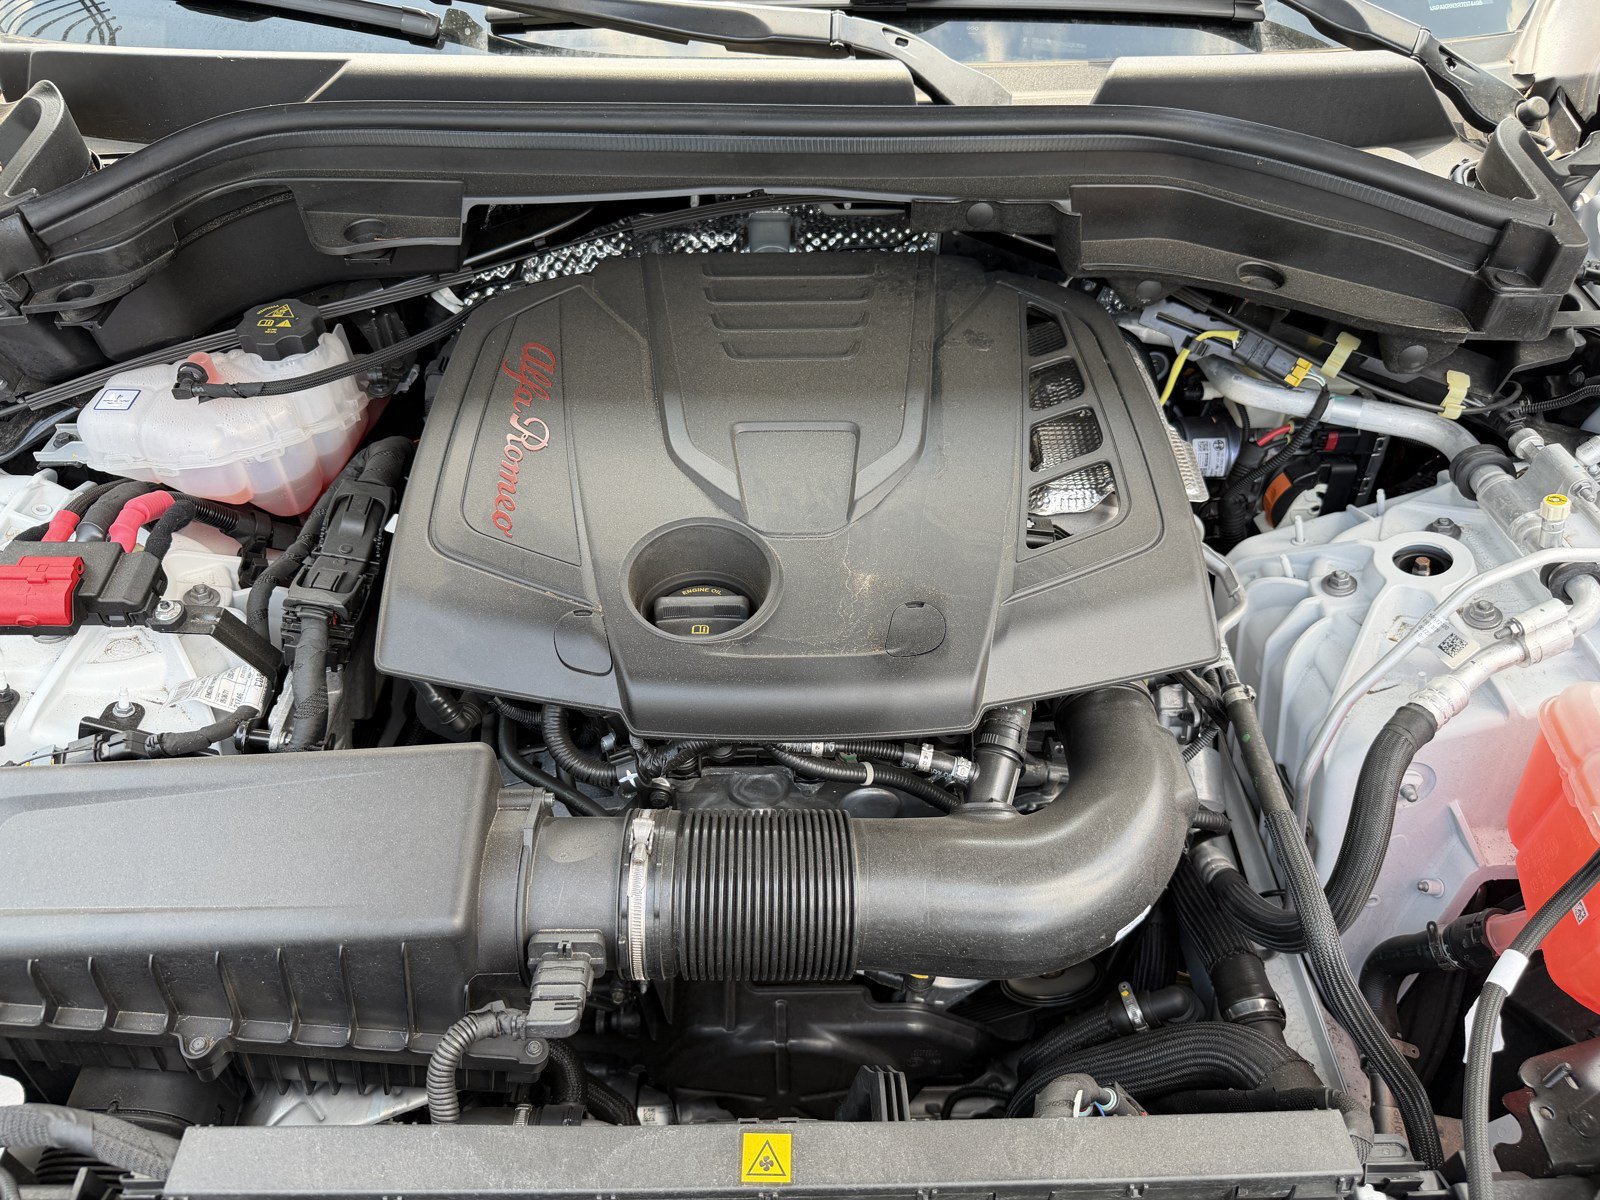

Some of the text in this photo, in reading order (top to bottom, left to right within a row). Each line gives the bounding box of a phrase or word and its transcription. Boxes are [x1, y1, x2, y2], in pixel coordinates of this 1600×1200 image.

[492, 342, 556, 538] Alfa Romeo
[681, 587, 722, 596] ENGINE OIL
